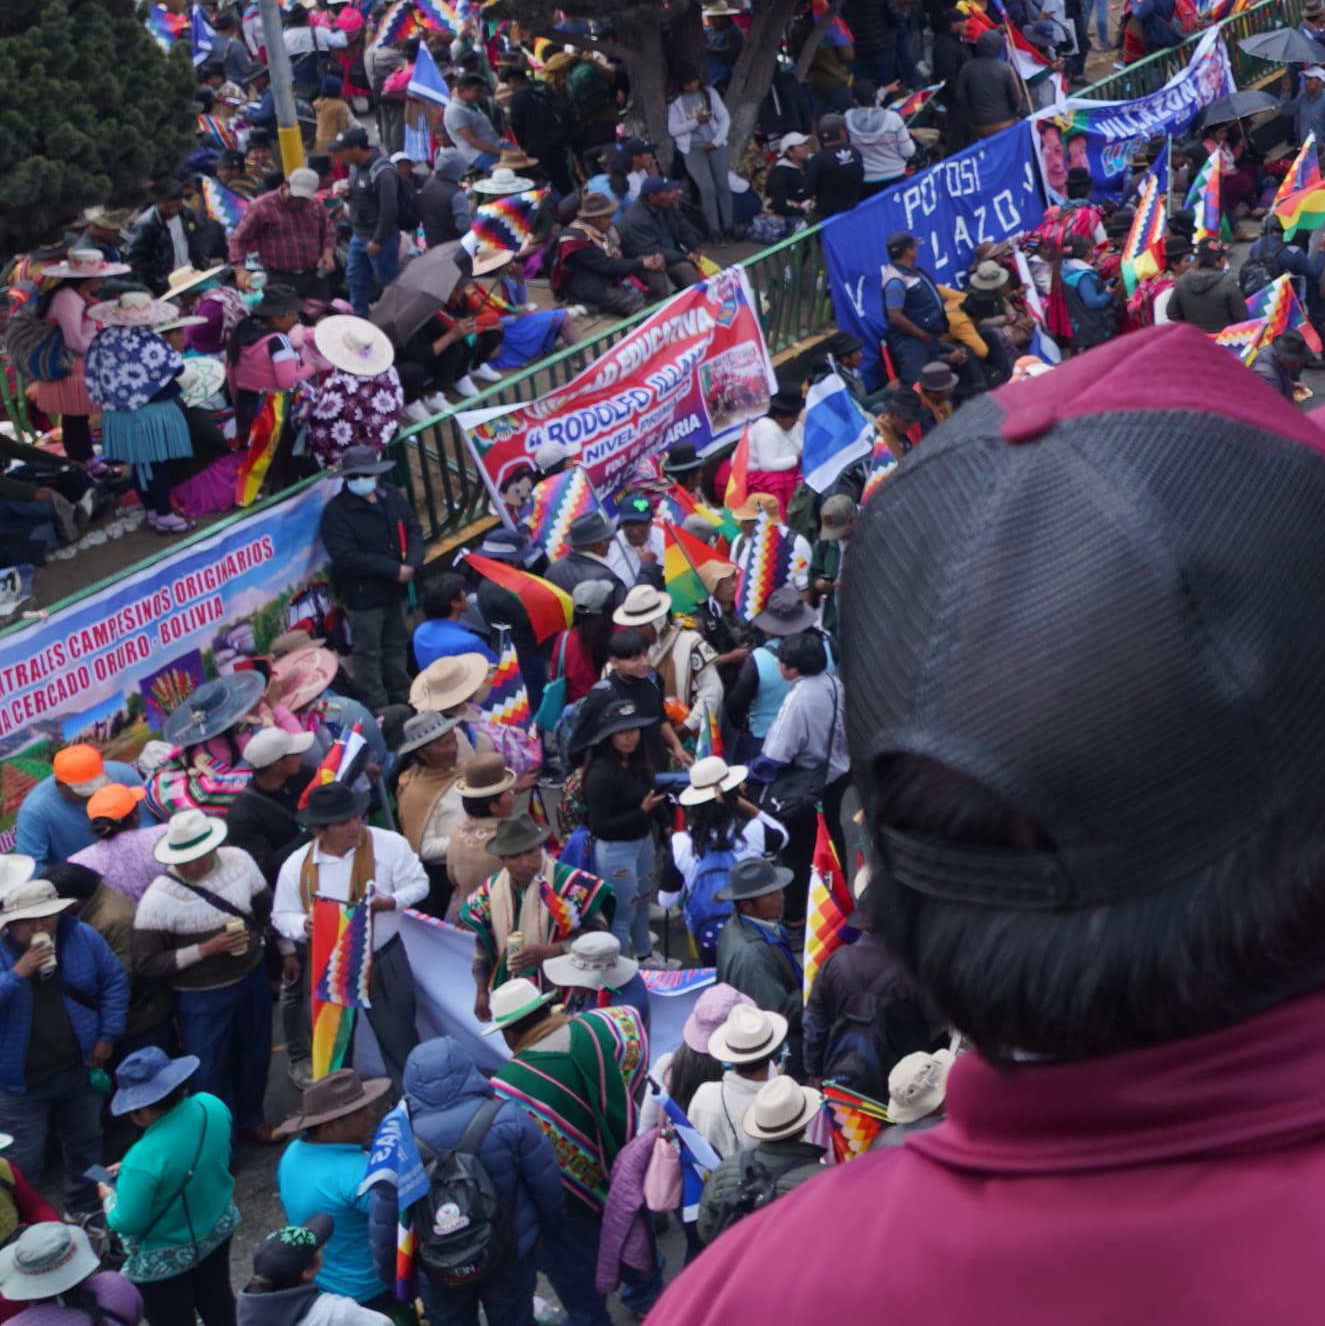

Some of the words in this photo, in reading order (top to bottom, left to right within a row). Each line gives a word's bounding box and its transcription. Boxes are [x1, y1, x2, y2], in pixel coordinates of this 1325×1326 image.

[1095, 78, 1198, 144] VILLAZON
[616, 305, 717, 378] EDUCATIVA
[548, 387, 652, 446] RODOLFO
[584, 428, 636, 465] NIVEL
[67, 588, 171, 659] CAMPESINOS
[174, 535, 274, 602] ORIGINARIOS
[11, 665, 91, 725] CERCADO
[94, 634, 150, 680] ORURO
[159, 596, 224, 645] BOLIVIA
